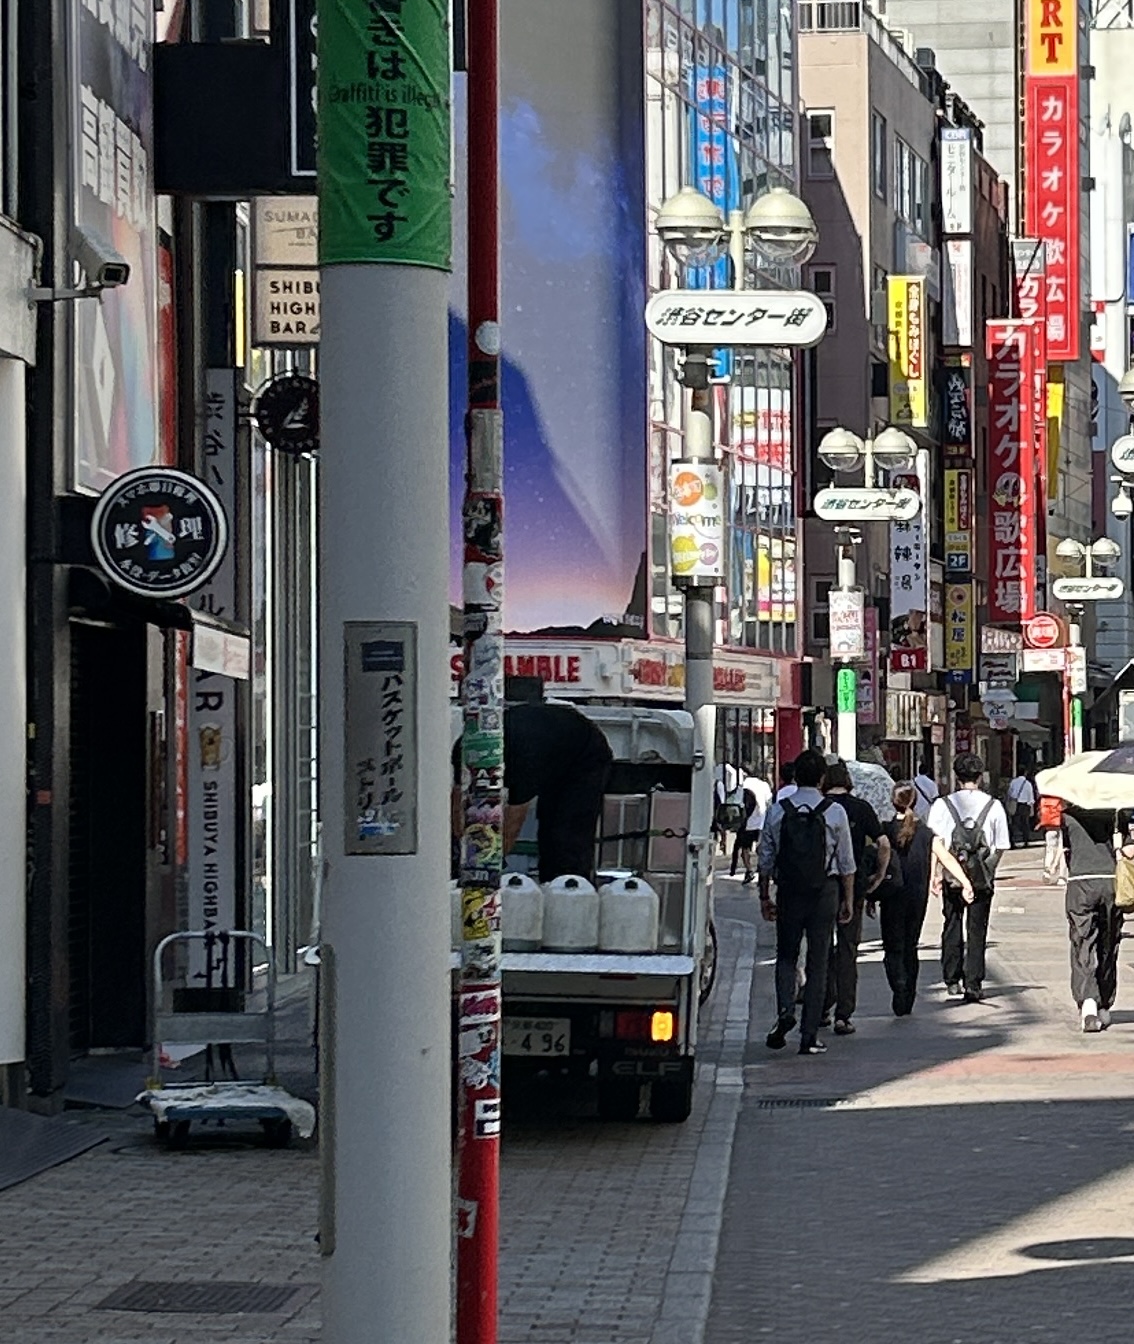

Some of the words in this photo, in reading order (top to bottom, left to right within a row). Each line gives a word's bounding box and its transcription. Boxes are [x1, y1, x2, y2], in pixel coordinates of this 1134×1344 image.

[270, 281, 320, 294] SHIB
[655, 307, 814, 328] 渋谷センター街
[270, 320, 307, 335] BAR
[950, 555, 966, 568] 2F
[203, 780, 218, 857] SHIBUYA
[612, 1060, 683, 1076] ELF
